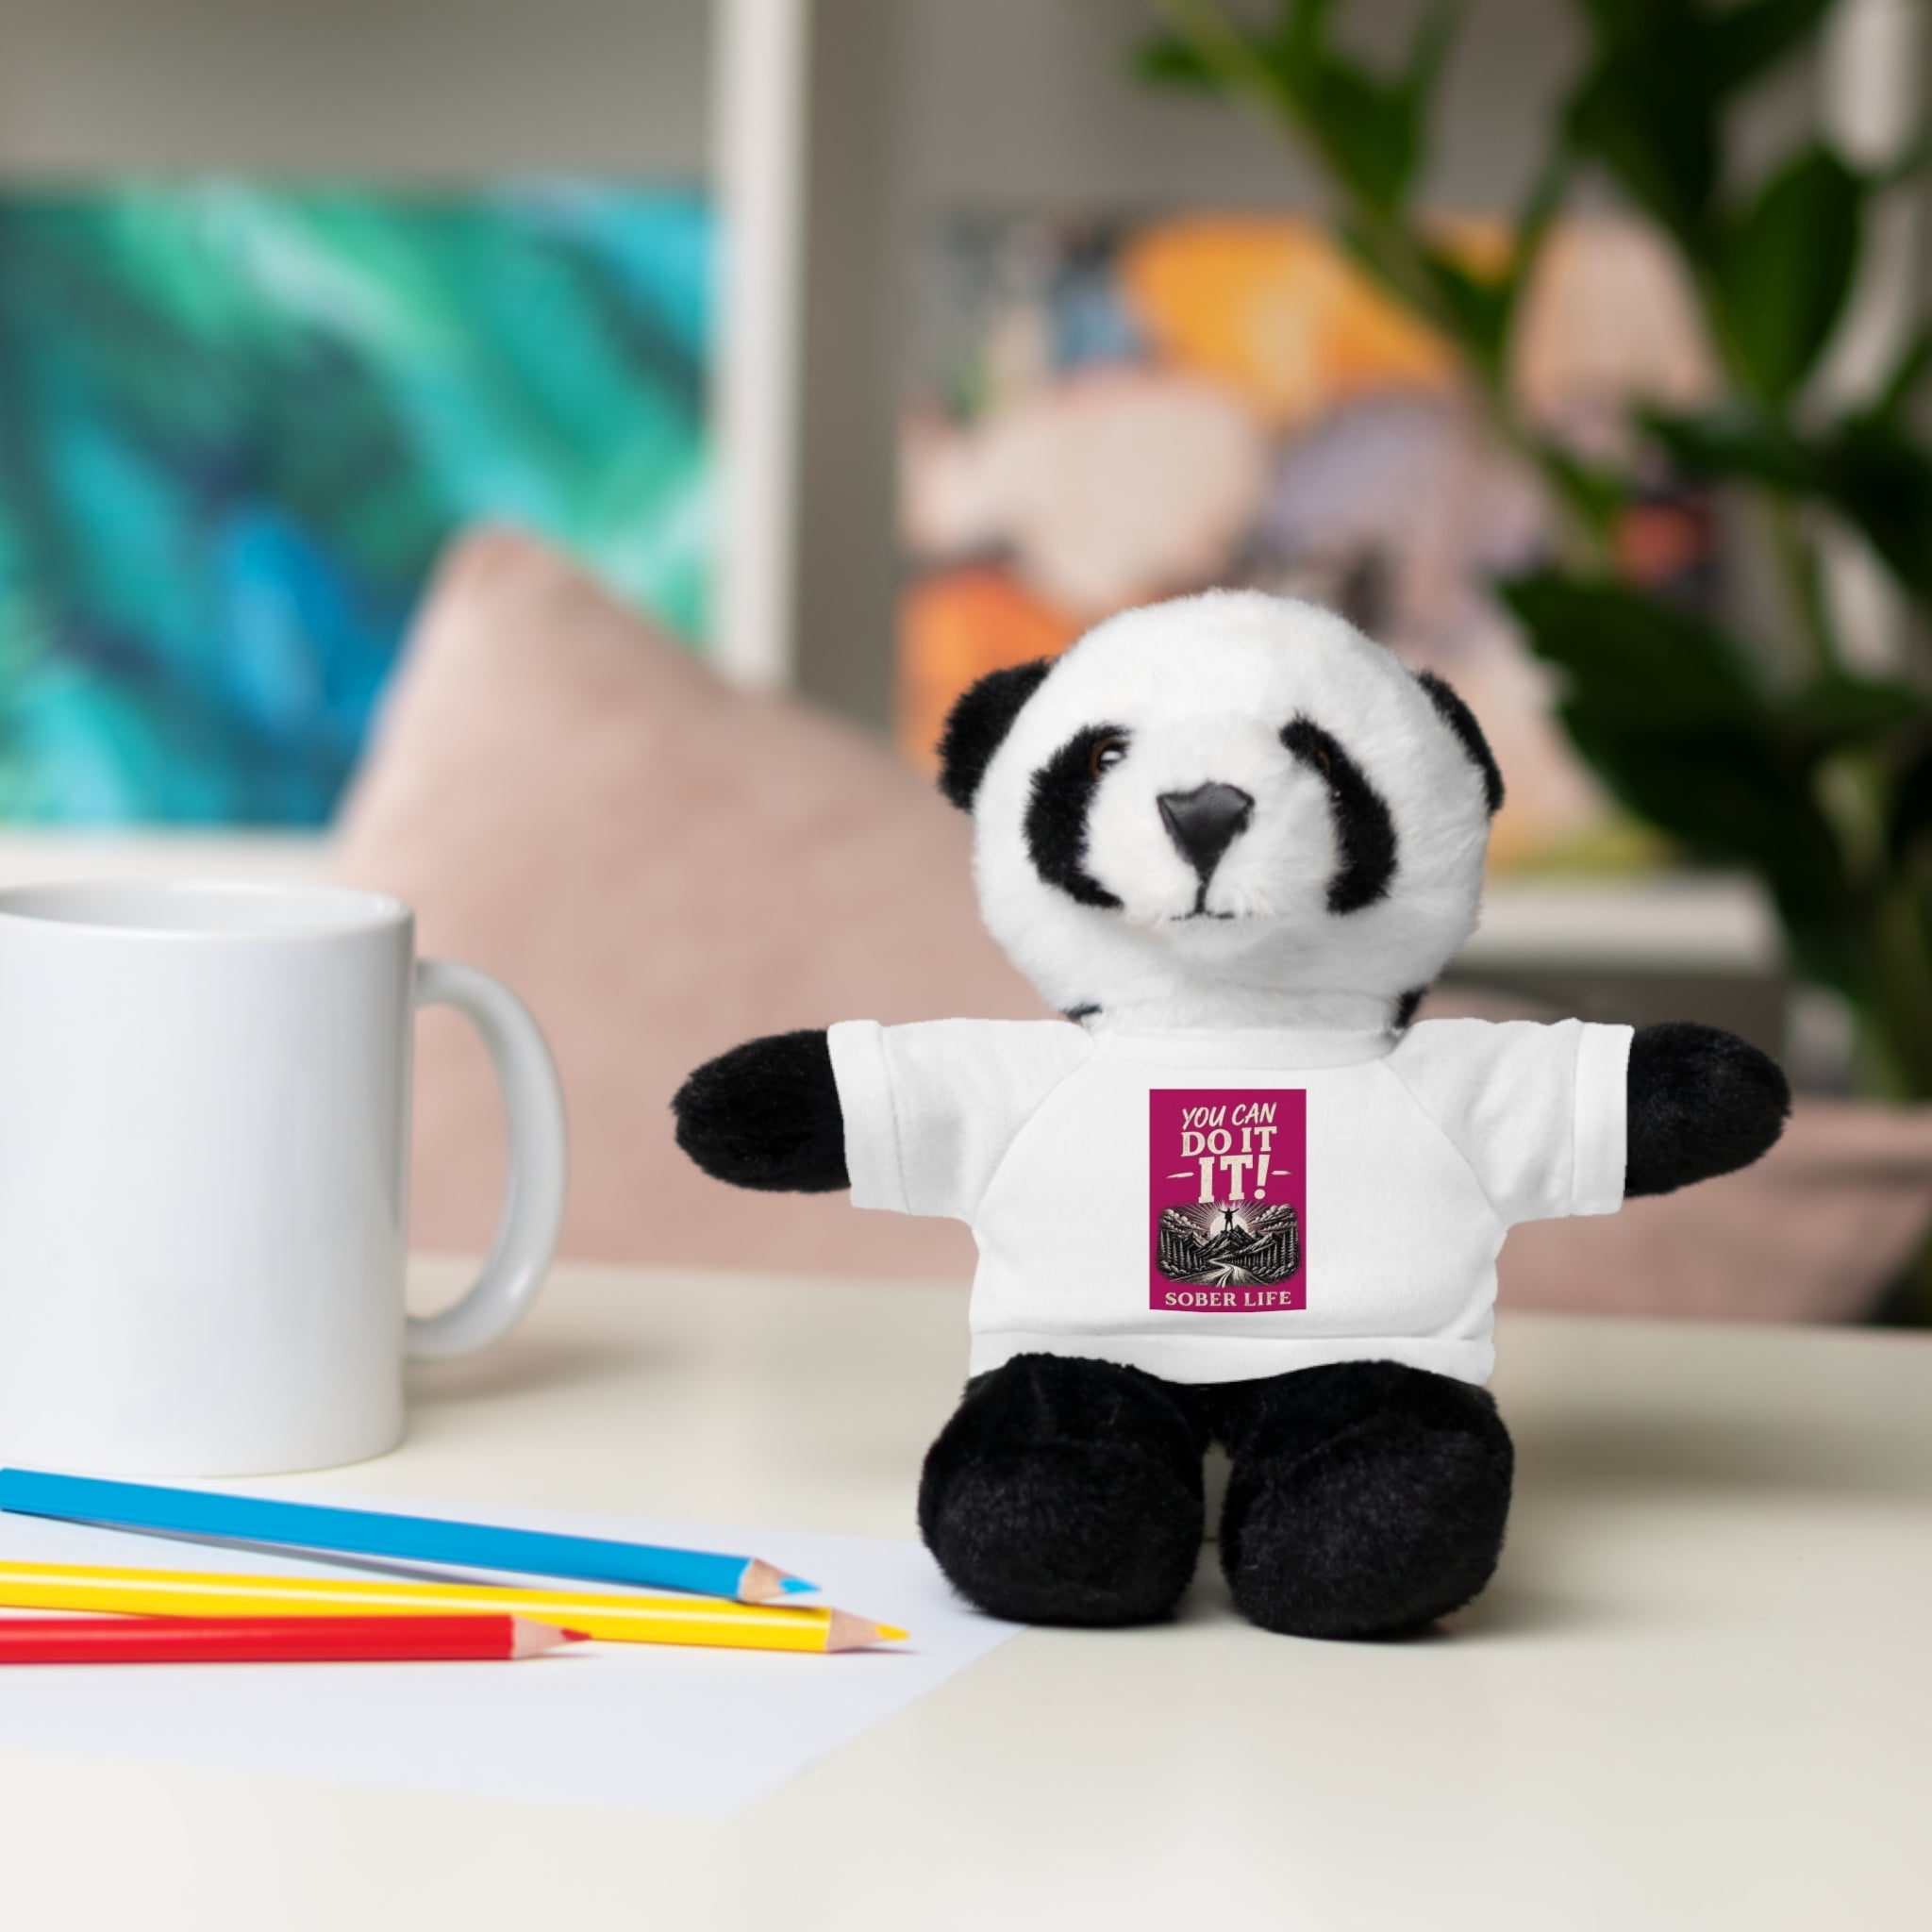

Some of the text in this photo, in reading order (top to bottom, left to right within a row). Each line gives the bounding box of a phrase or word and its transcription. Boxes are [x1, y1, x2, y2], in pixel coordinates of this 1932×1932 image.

[1182, 1102, 1277, 1131] YOU CAN
[1180, 1125, 1277, 1157] DO IT
[1198, 1154, 1271, 1204] IT!
[1165, 1291, 1291, 1307] SOBER LIFE
